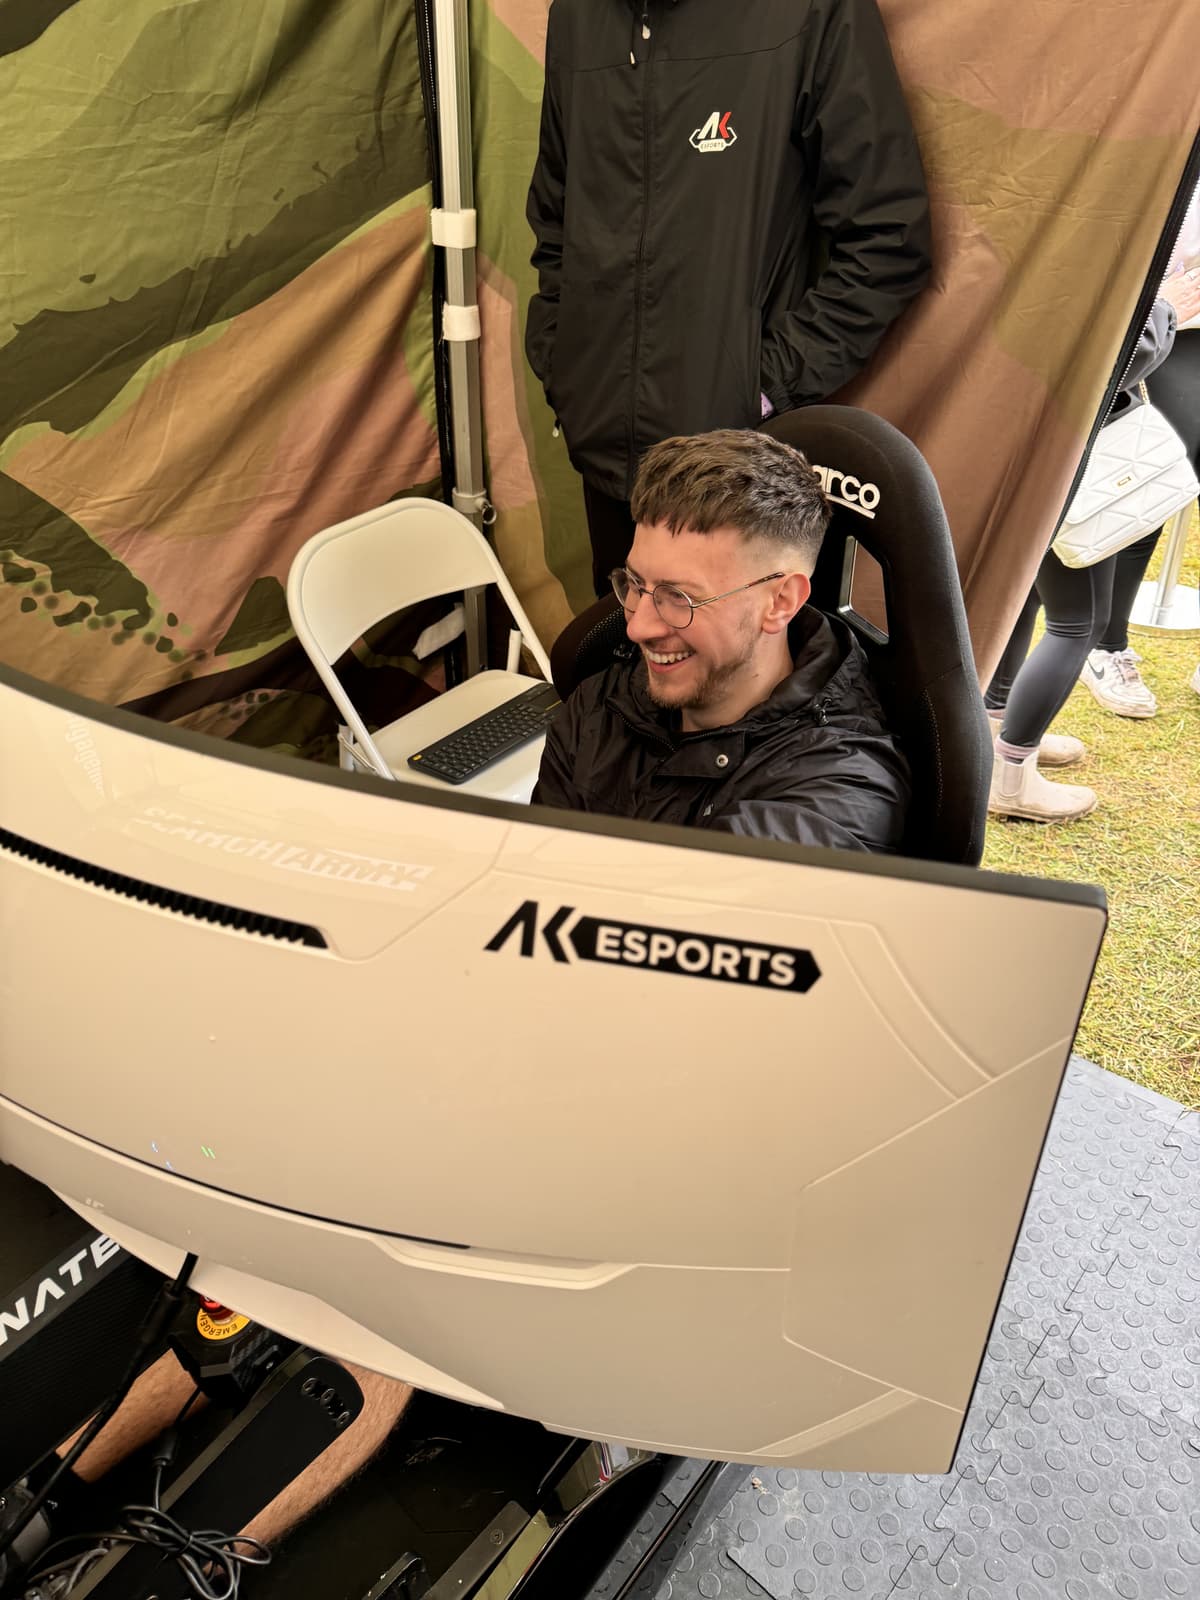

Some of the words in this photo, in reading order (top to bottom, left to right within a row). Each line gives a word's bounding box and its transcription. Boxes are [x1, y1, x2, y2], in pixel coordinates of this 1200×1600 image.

[483, 900, 576, 965] AK
[595, 925, 797, 987] ESPORTS
[0, 1233, 121, 1346] NATE
